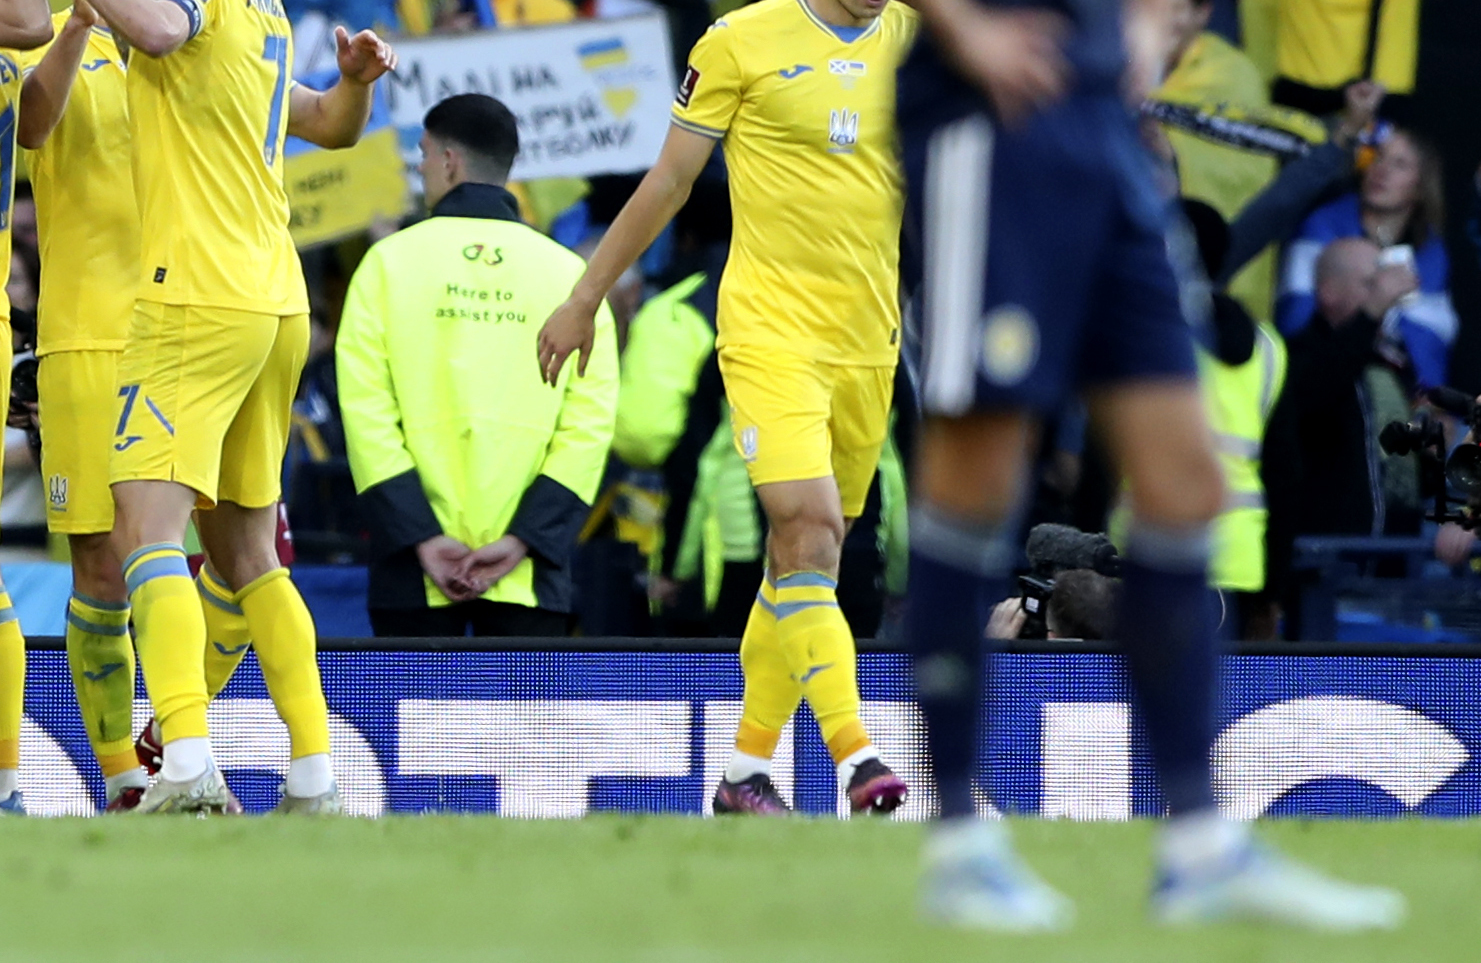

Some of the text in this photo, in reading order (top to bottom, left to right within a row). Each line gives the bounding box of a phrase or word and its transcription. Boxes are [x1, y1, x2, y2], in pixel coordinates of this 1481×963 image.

[445, 283, 514, 302] Here to
[435, 307, 526, 325] assist you
[116, 384, 140, 436] 7
